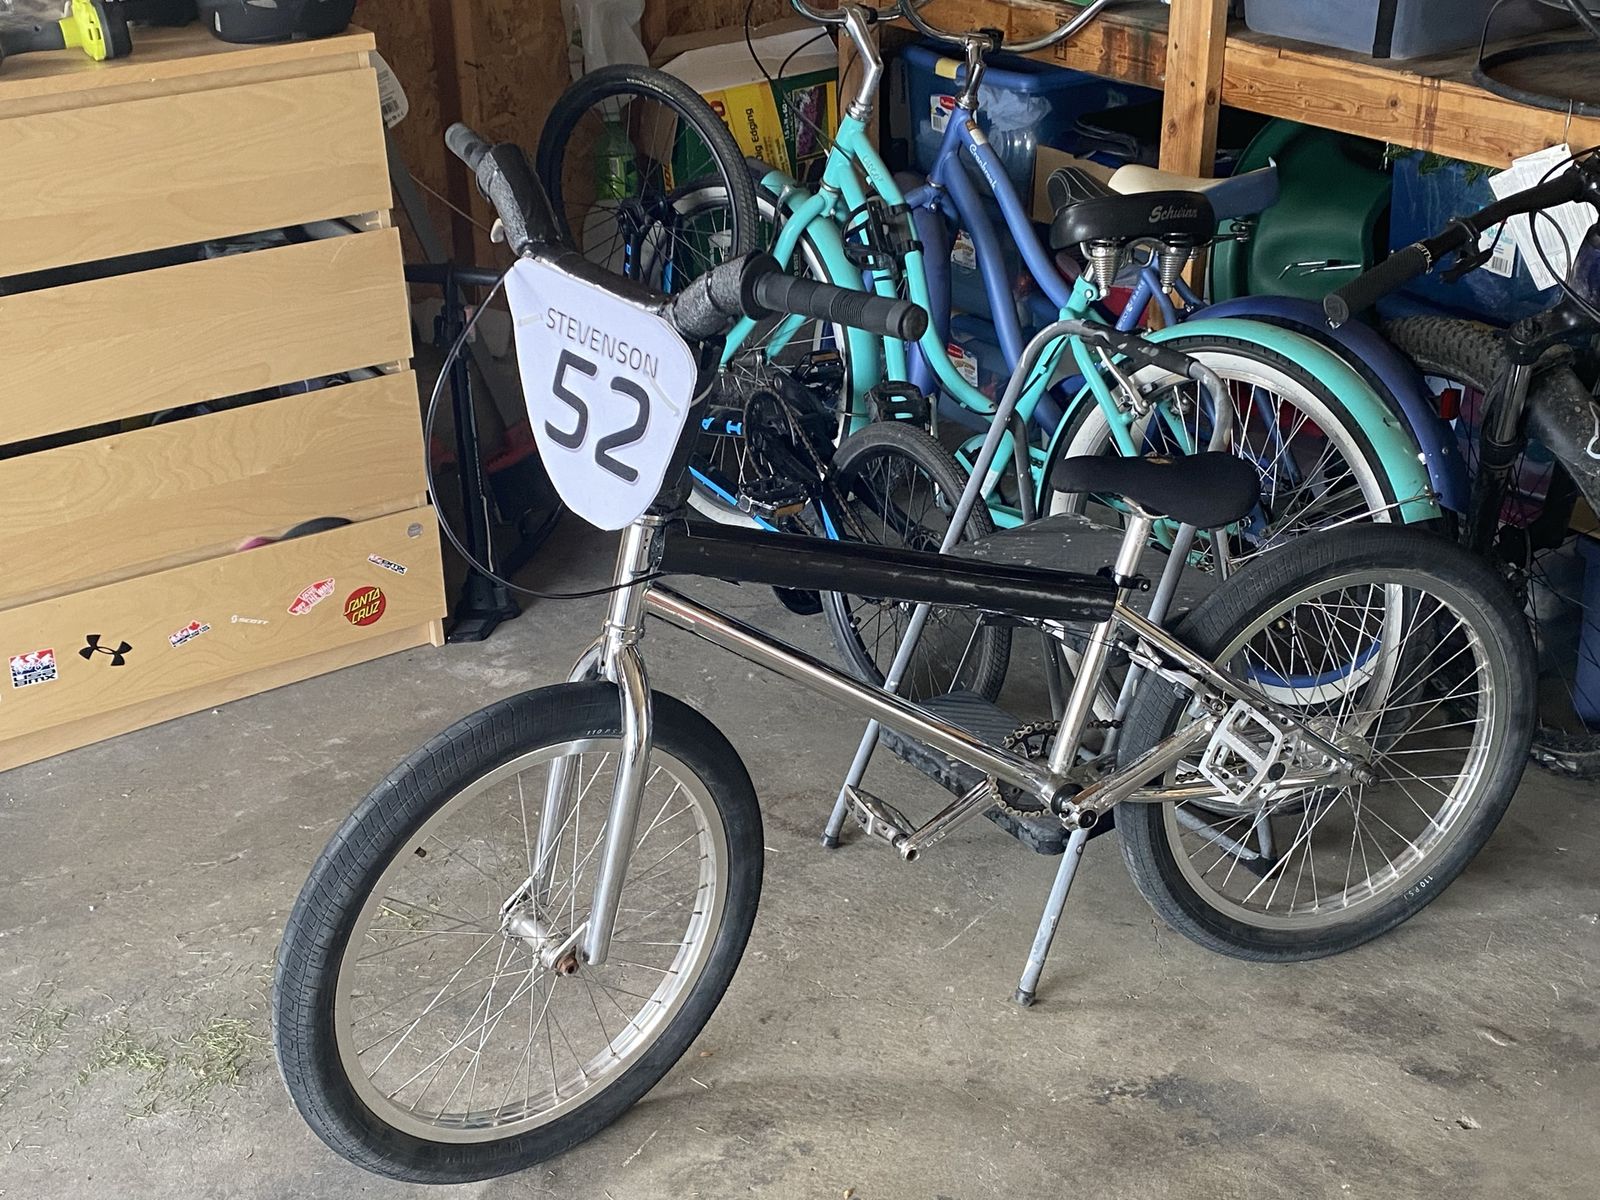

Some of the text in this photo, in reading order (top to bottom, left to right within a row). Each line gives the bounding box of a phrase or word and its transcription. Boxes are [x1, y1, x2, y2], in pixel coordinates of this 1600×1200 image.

[745, 107, 760, 143] Edging
[969, 143, 998, 190] Cranbrook
[1148, 204, 1198, 224] Schwinn
[546, 307, 659, 379] STEVENSON
[544, 348, 651, 482] 52
[343, 587, 381, 616] SANTA
[352, 601, 381, 625] CRUZ
[1420, 875, 1433, 888] 110
